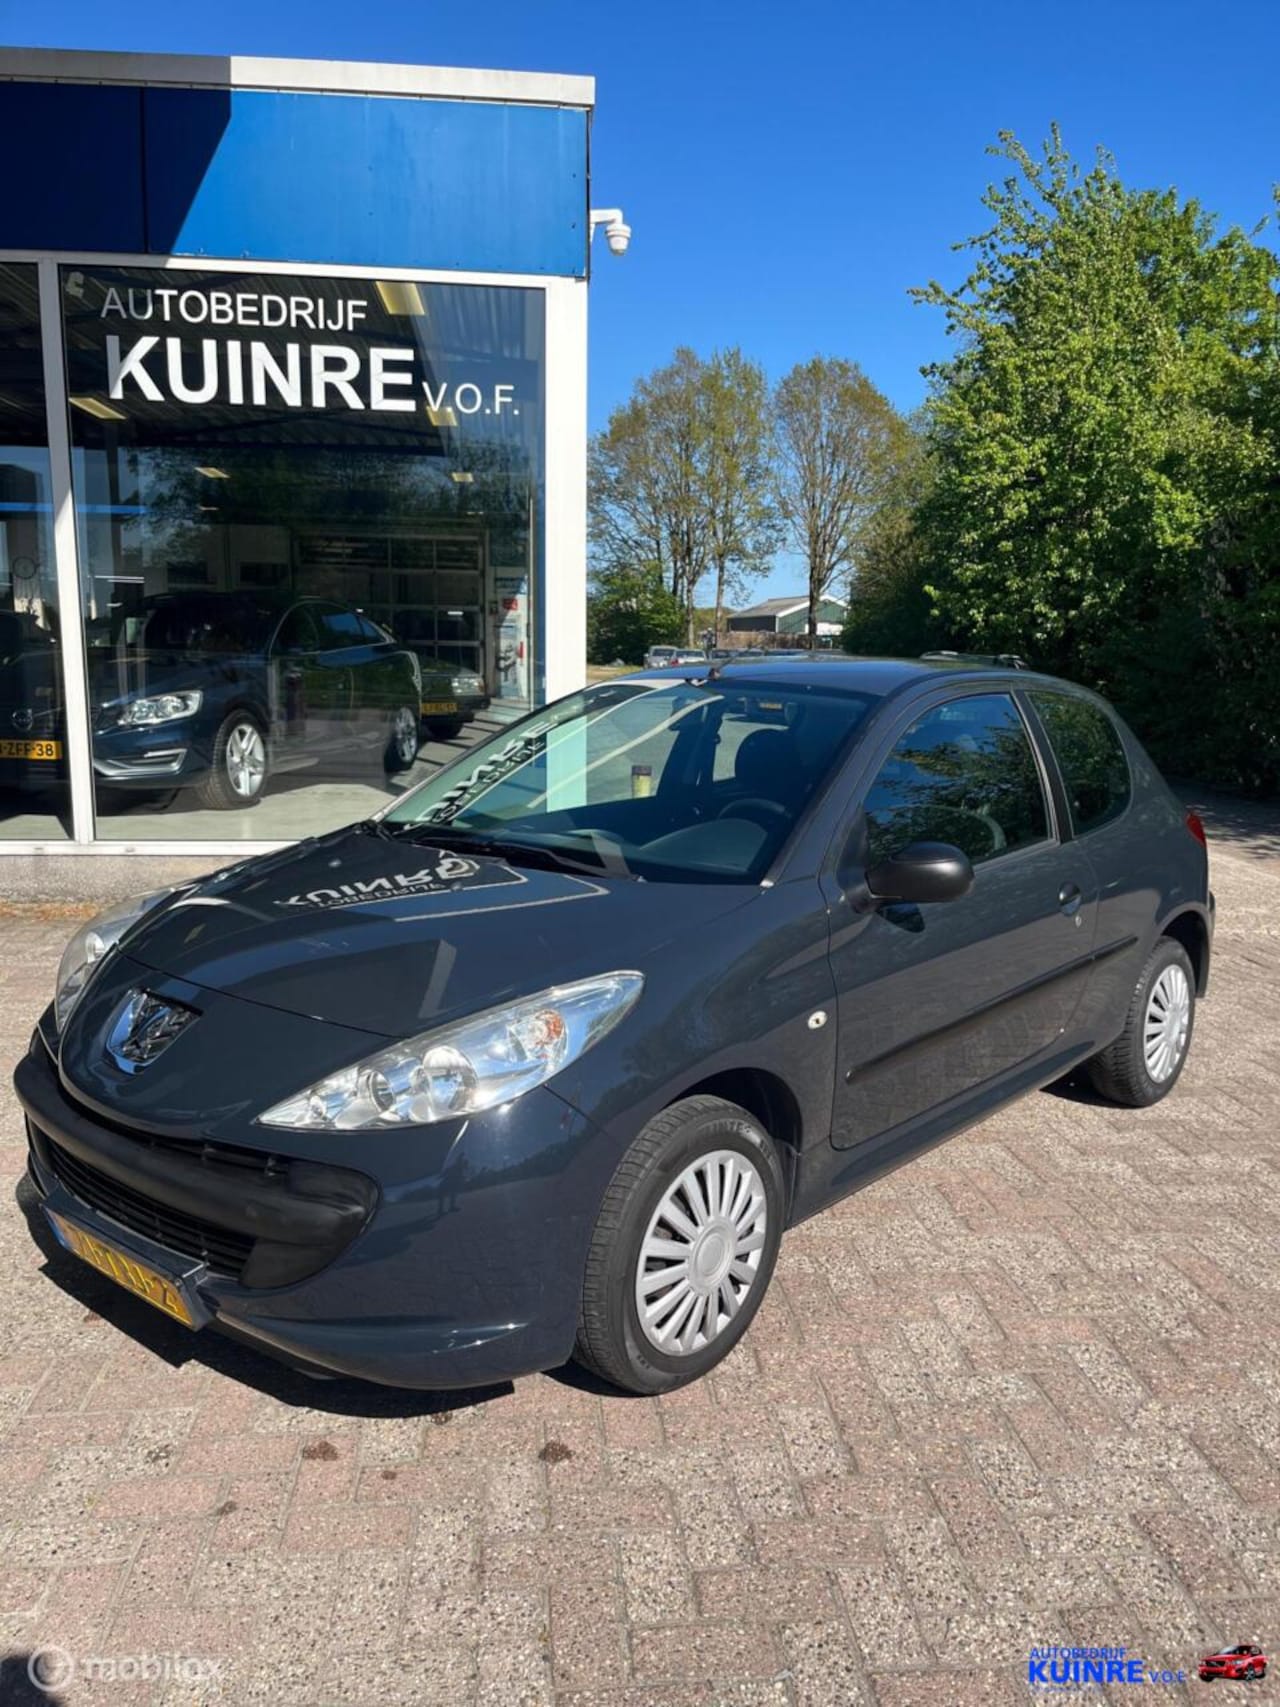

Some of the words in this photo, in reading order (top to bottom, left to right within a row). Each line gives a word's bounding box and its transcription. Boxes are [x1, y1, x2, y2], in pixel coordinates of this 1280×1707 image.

[101, 287, 368, 331] AUTOBEDRIJF
[106, 335, 416, 412] KUINRE
[422, 381, 519, 415] V.O.F.
